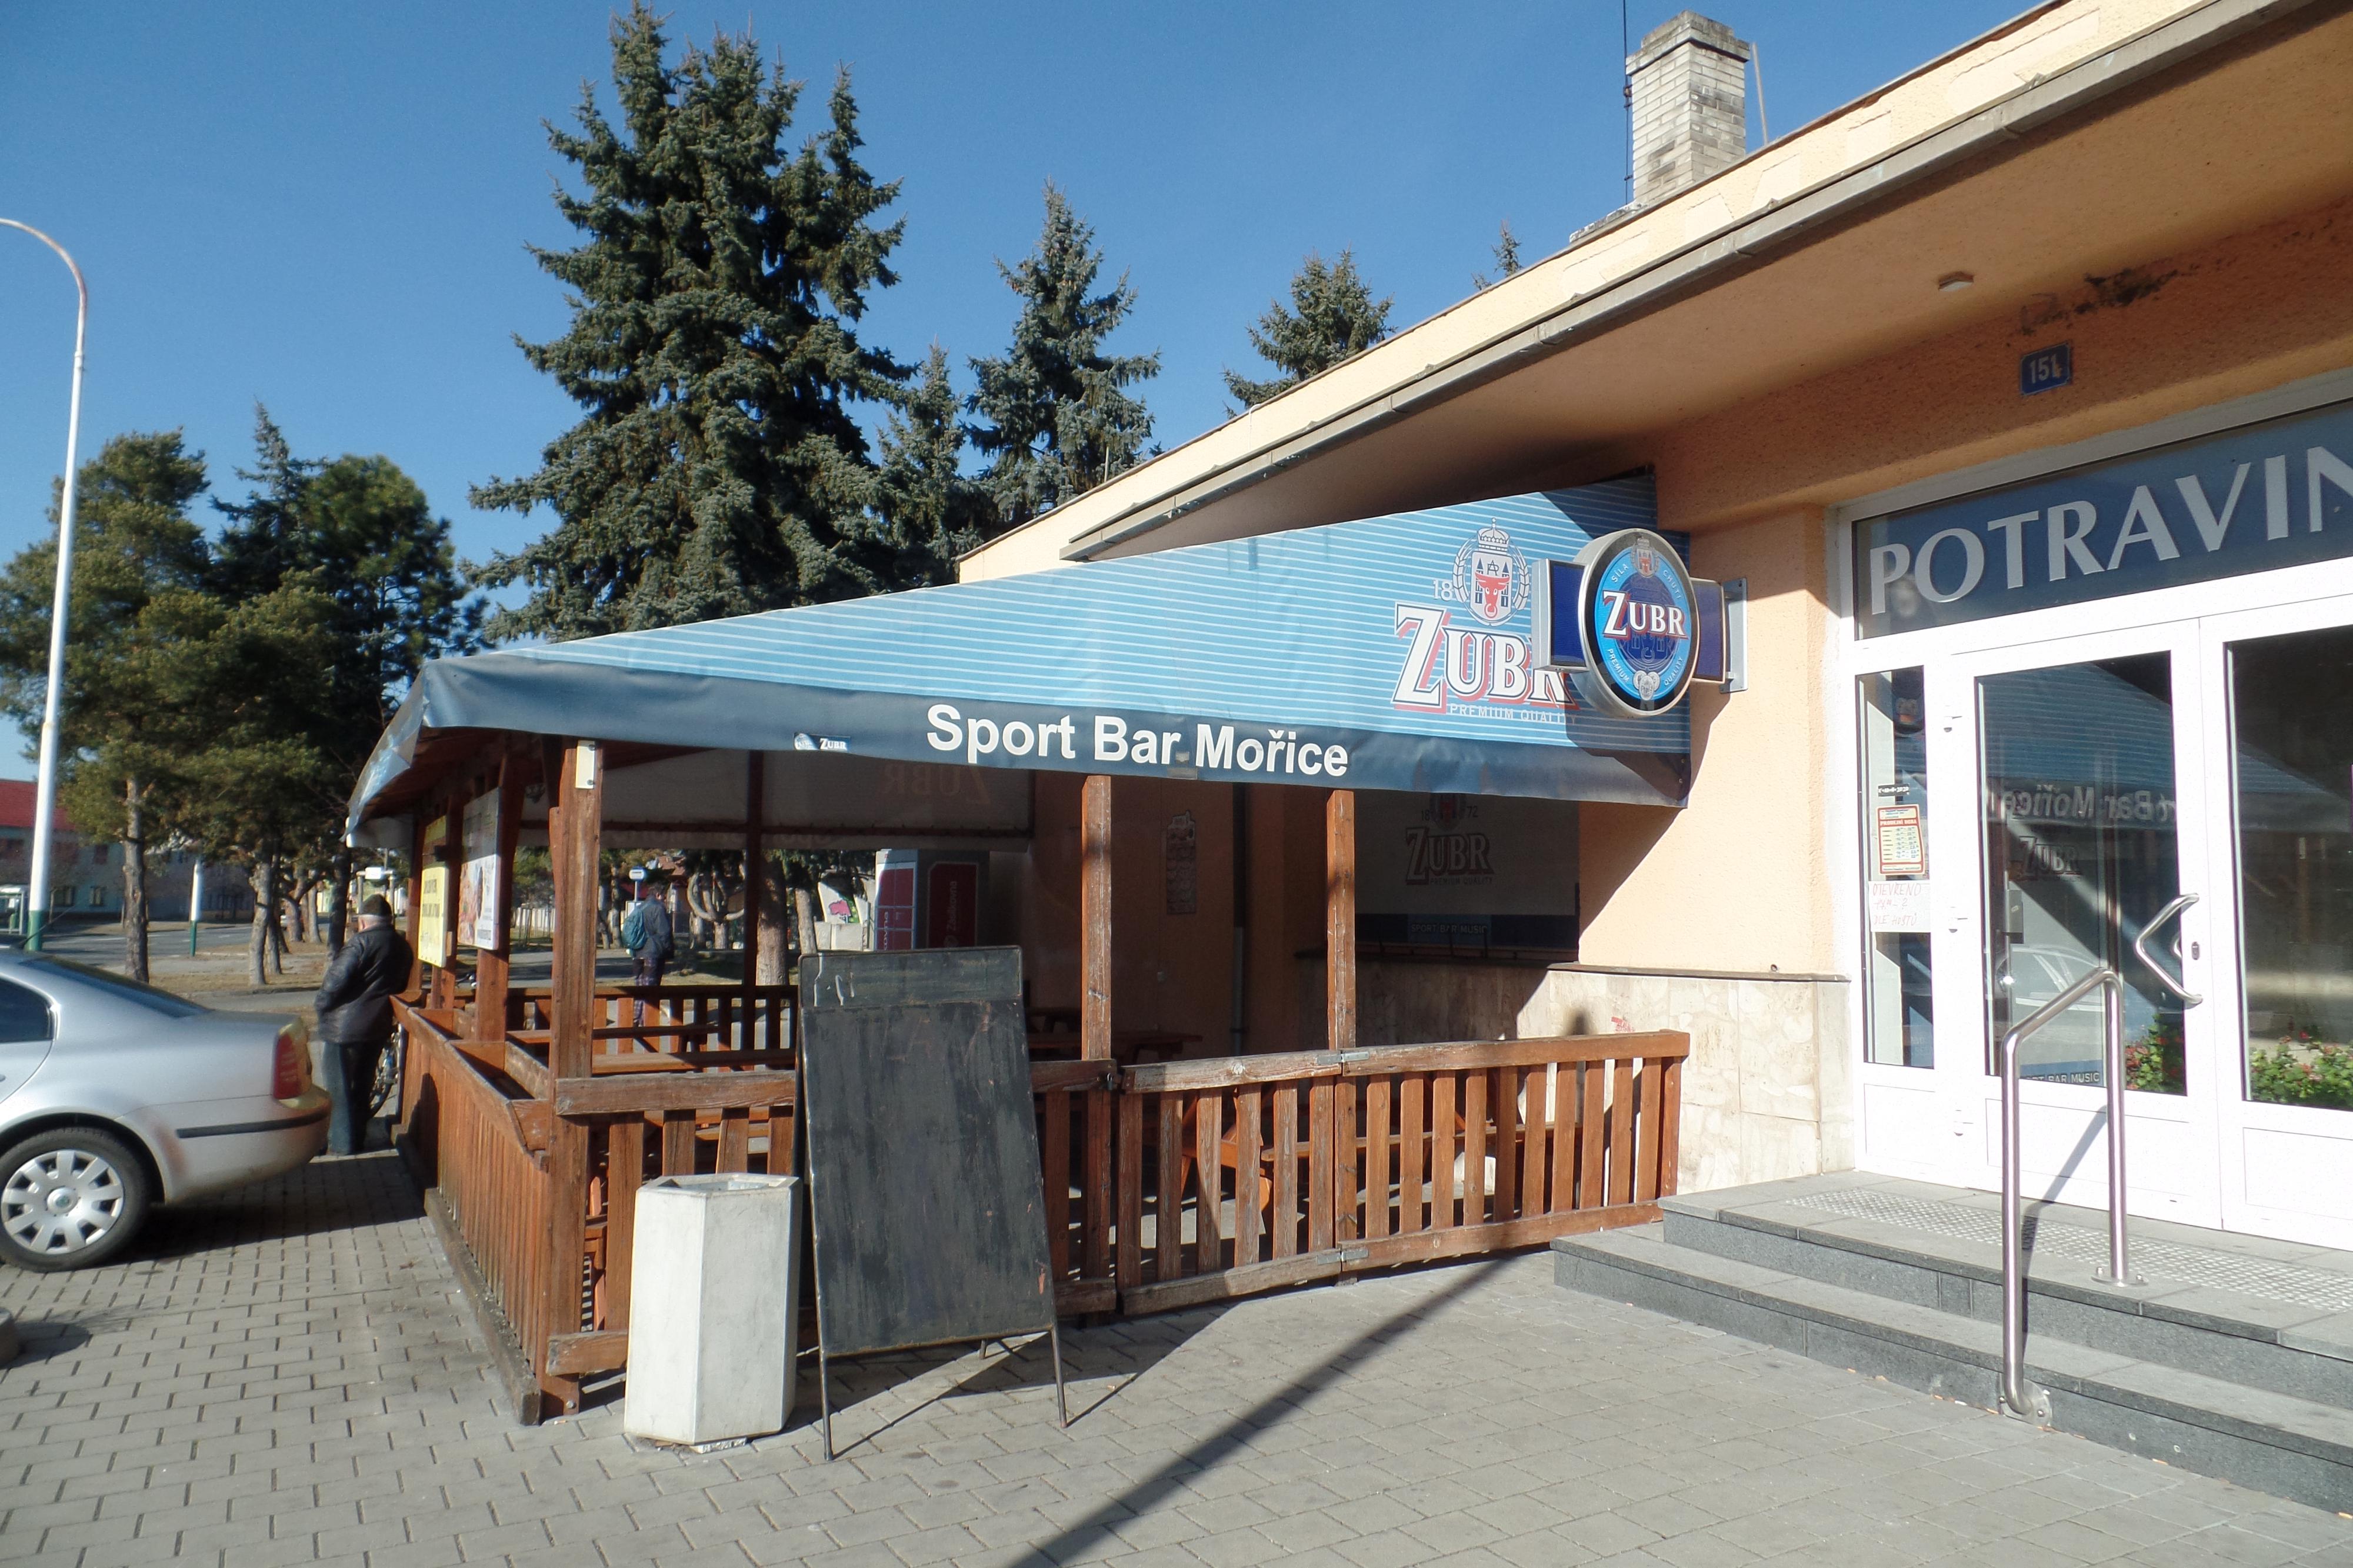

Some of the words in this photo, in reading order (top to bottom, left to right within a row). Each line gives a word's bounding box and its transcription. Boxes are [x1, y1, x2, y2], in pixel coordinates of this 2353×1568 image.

[1602, 590, 1688, 639] ZUBR
[1607, 648, 1630, 682] PREMIUM
[1664, 657, 1684, 686] QUALITY
[1450, 705, 1514, 720] PREMIUM
[819, 737, 848, 751] ZUBR
[926, 703, 1076, 764] Sport
[1094, 715, 1182, 765] Bar
[1195, 723, 1349, 776] Mořice
[1467, 805, 1478, 818] 72
[1405, 826, 1495, 885] ZUBR
[1412, 924, 1437, 933] SPORT
[1461, 925, 1488, 935] MUSIC
[2071, 1073, 2099, 1083] MUSIC
